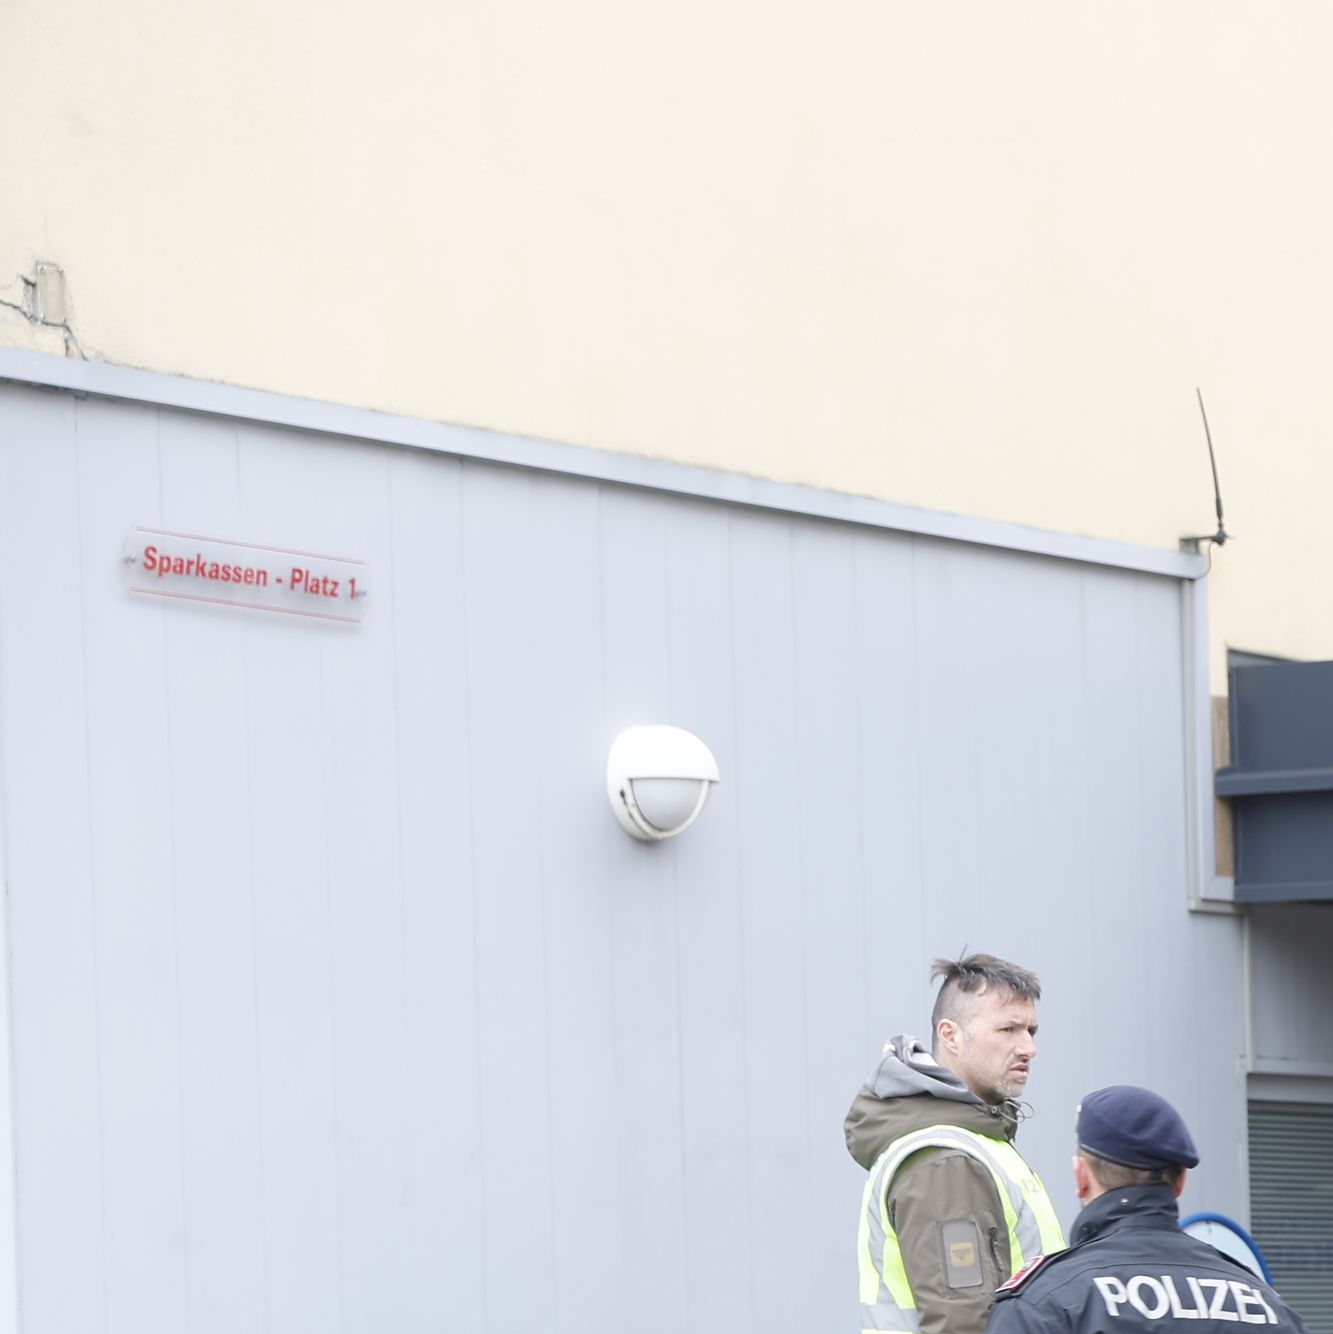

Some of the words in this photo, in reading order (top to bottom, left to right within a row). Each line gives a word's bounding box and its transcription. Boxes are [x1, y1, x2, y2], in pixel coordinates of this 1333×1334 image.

[143, 545, 268, 587] Sparkassen
[290, 568, 339, 598] Platz
[348, 578, 357, 600] 1
[1093, 1275, 1278, 1325] POLIZEI
